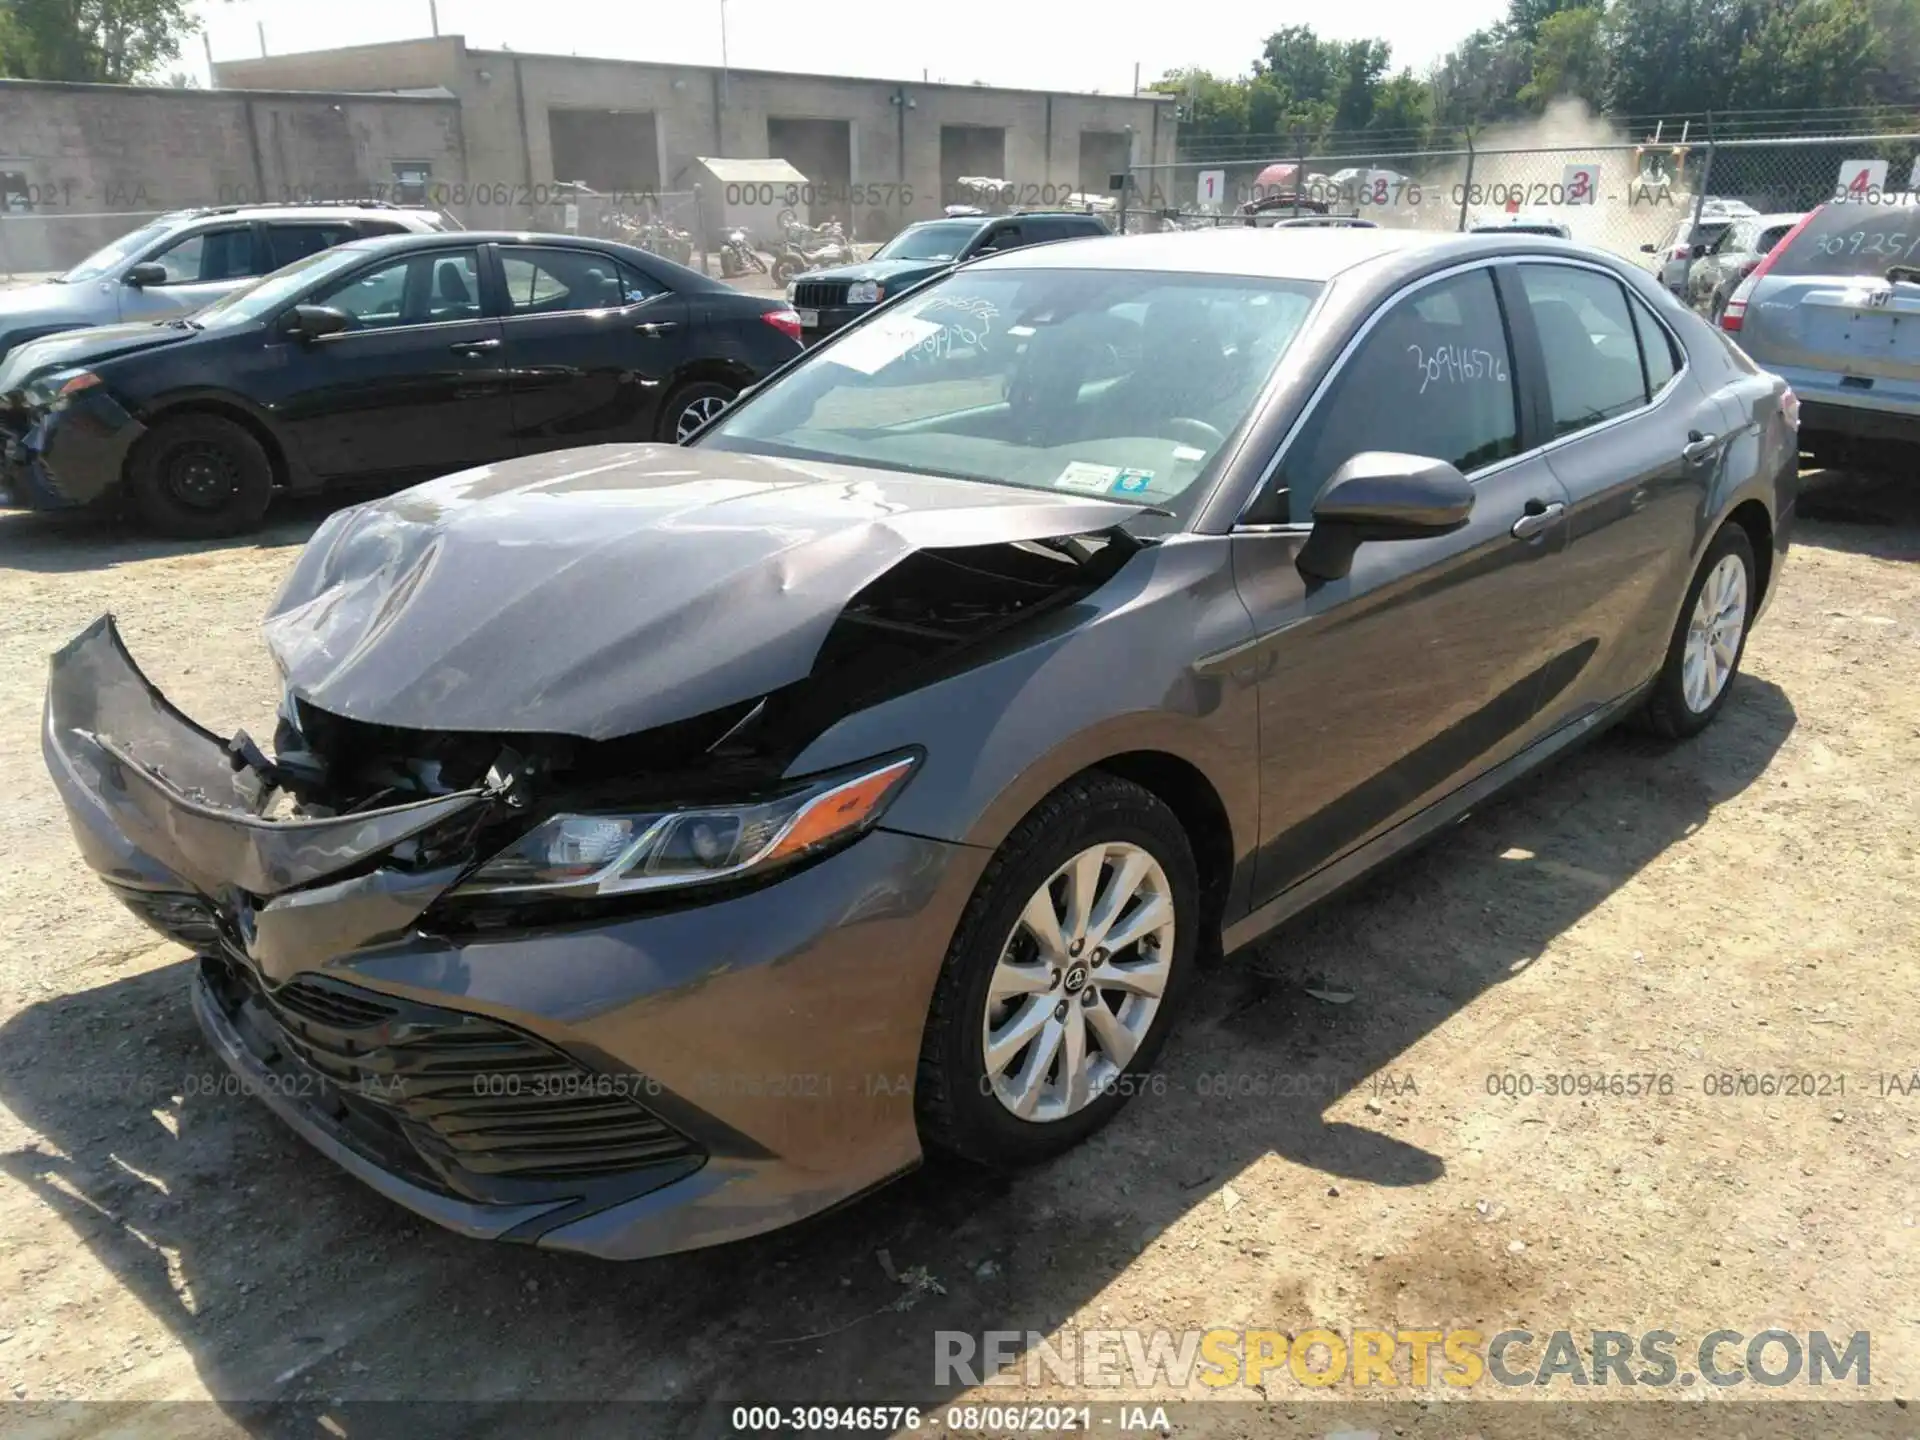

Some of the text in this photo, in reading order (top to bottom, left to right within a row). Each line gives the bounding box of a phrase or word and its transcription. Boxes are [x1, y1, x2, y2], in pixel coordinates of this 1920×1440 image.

[1206, 175, 1214, 199] 1
[1373, 178, 1388, 204] 2
[1571, 171, 1590, 198] 3
[1849, 168, 1870, 193] 4
[1407, 344, 1507, 394] 30946576
